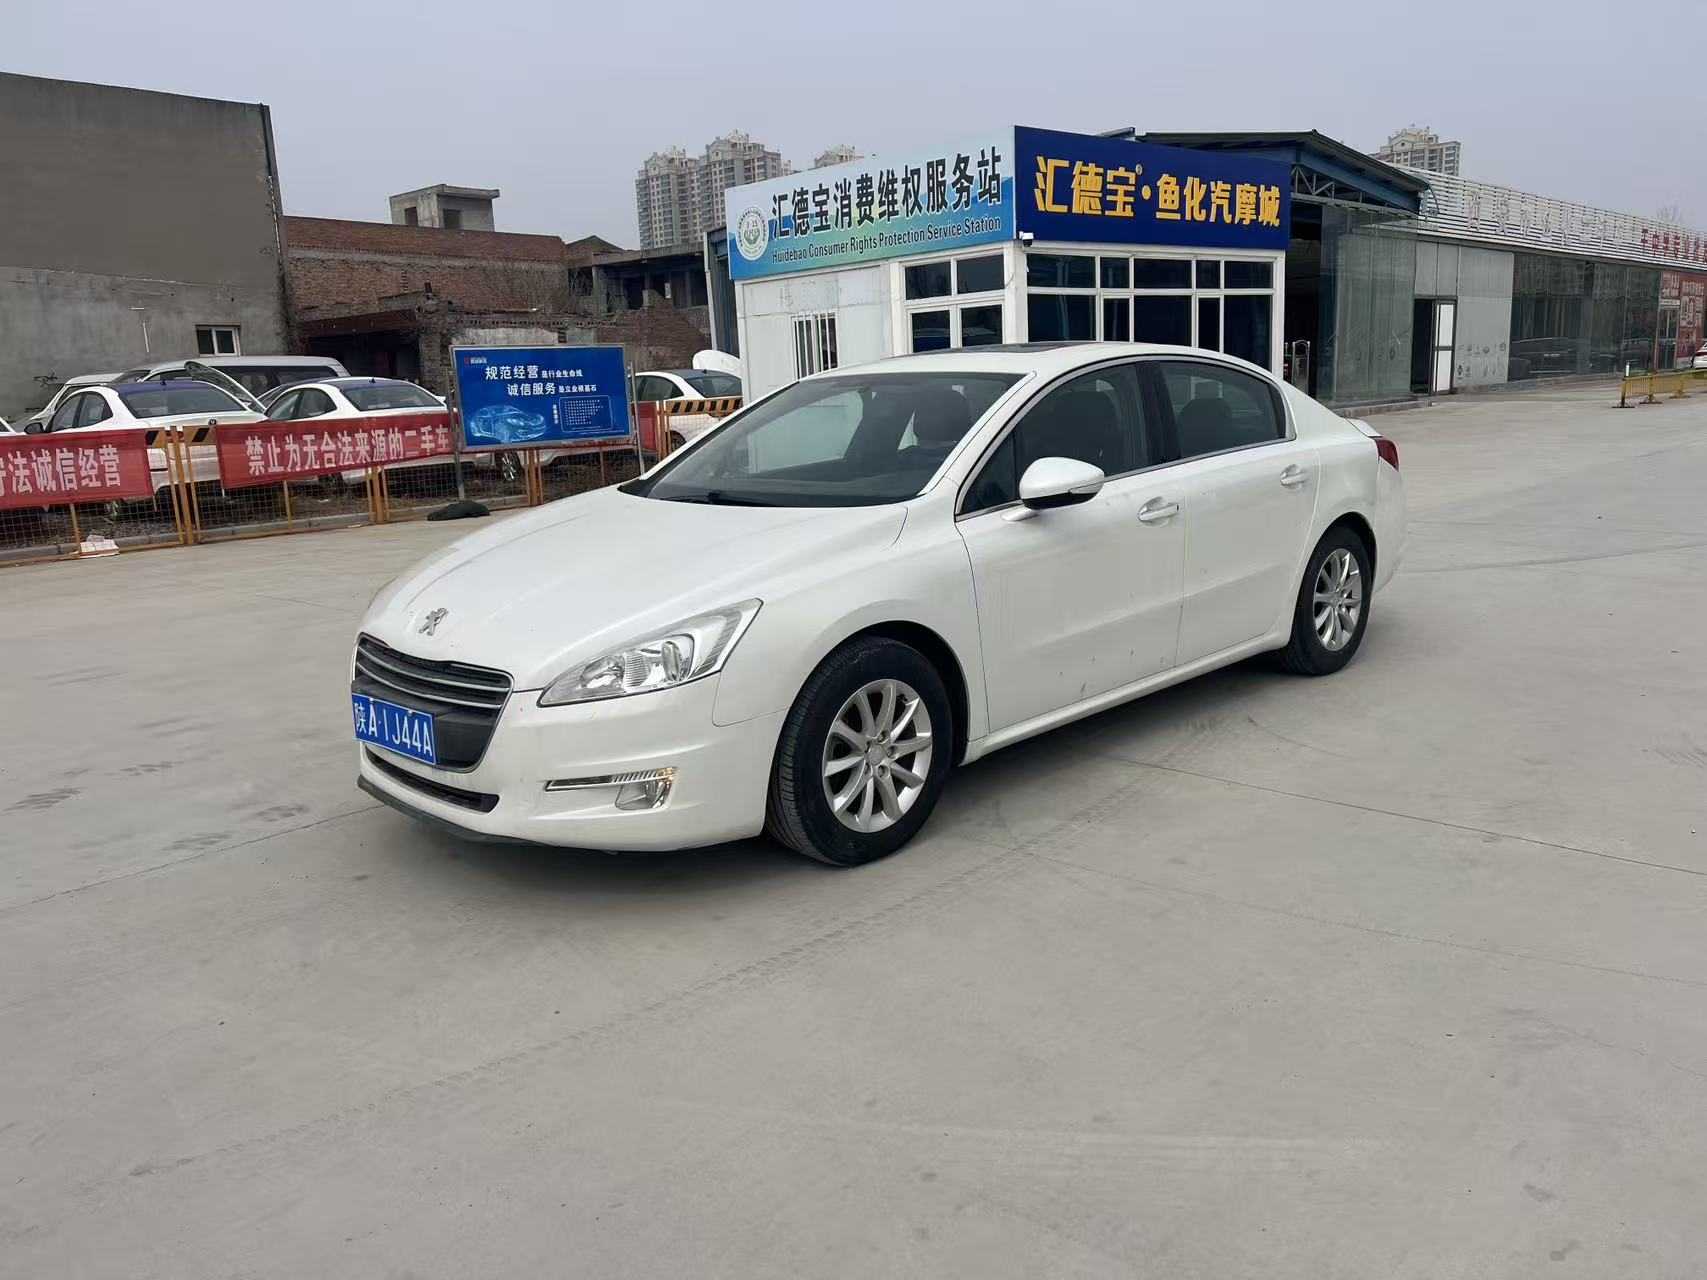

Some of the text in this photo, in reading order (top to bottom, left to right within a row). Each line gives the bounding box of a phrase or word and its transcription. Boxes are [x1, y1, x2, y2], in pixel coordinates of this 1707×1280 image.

[772, 146, 1001, 240] 汇德宝消费维权服务站
[772, 216, 1001, 264] Huidebao Consumer Rights Protection Service Station
[485, 365, 539, 380] 规范经营
[507, 382, 556, 397] 诚信服务
[245, 424, 449, 476] 禁止为无合法来源的二手车
